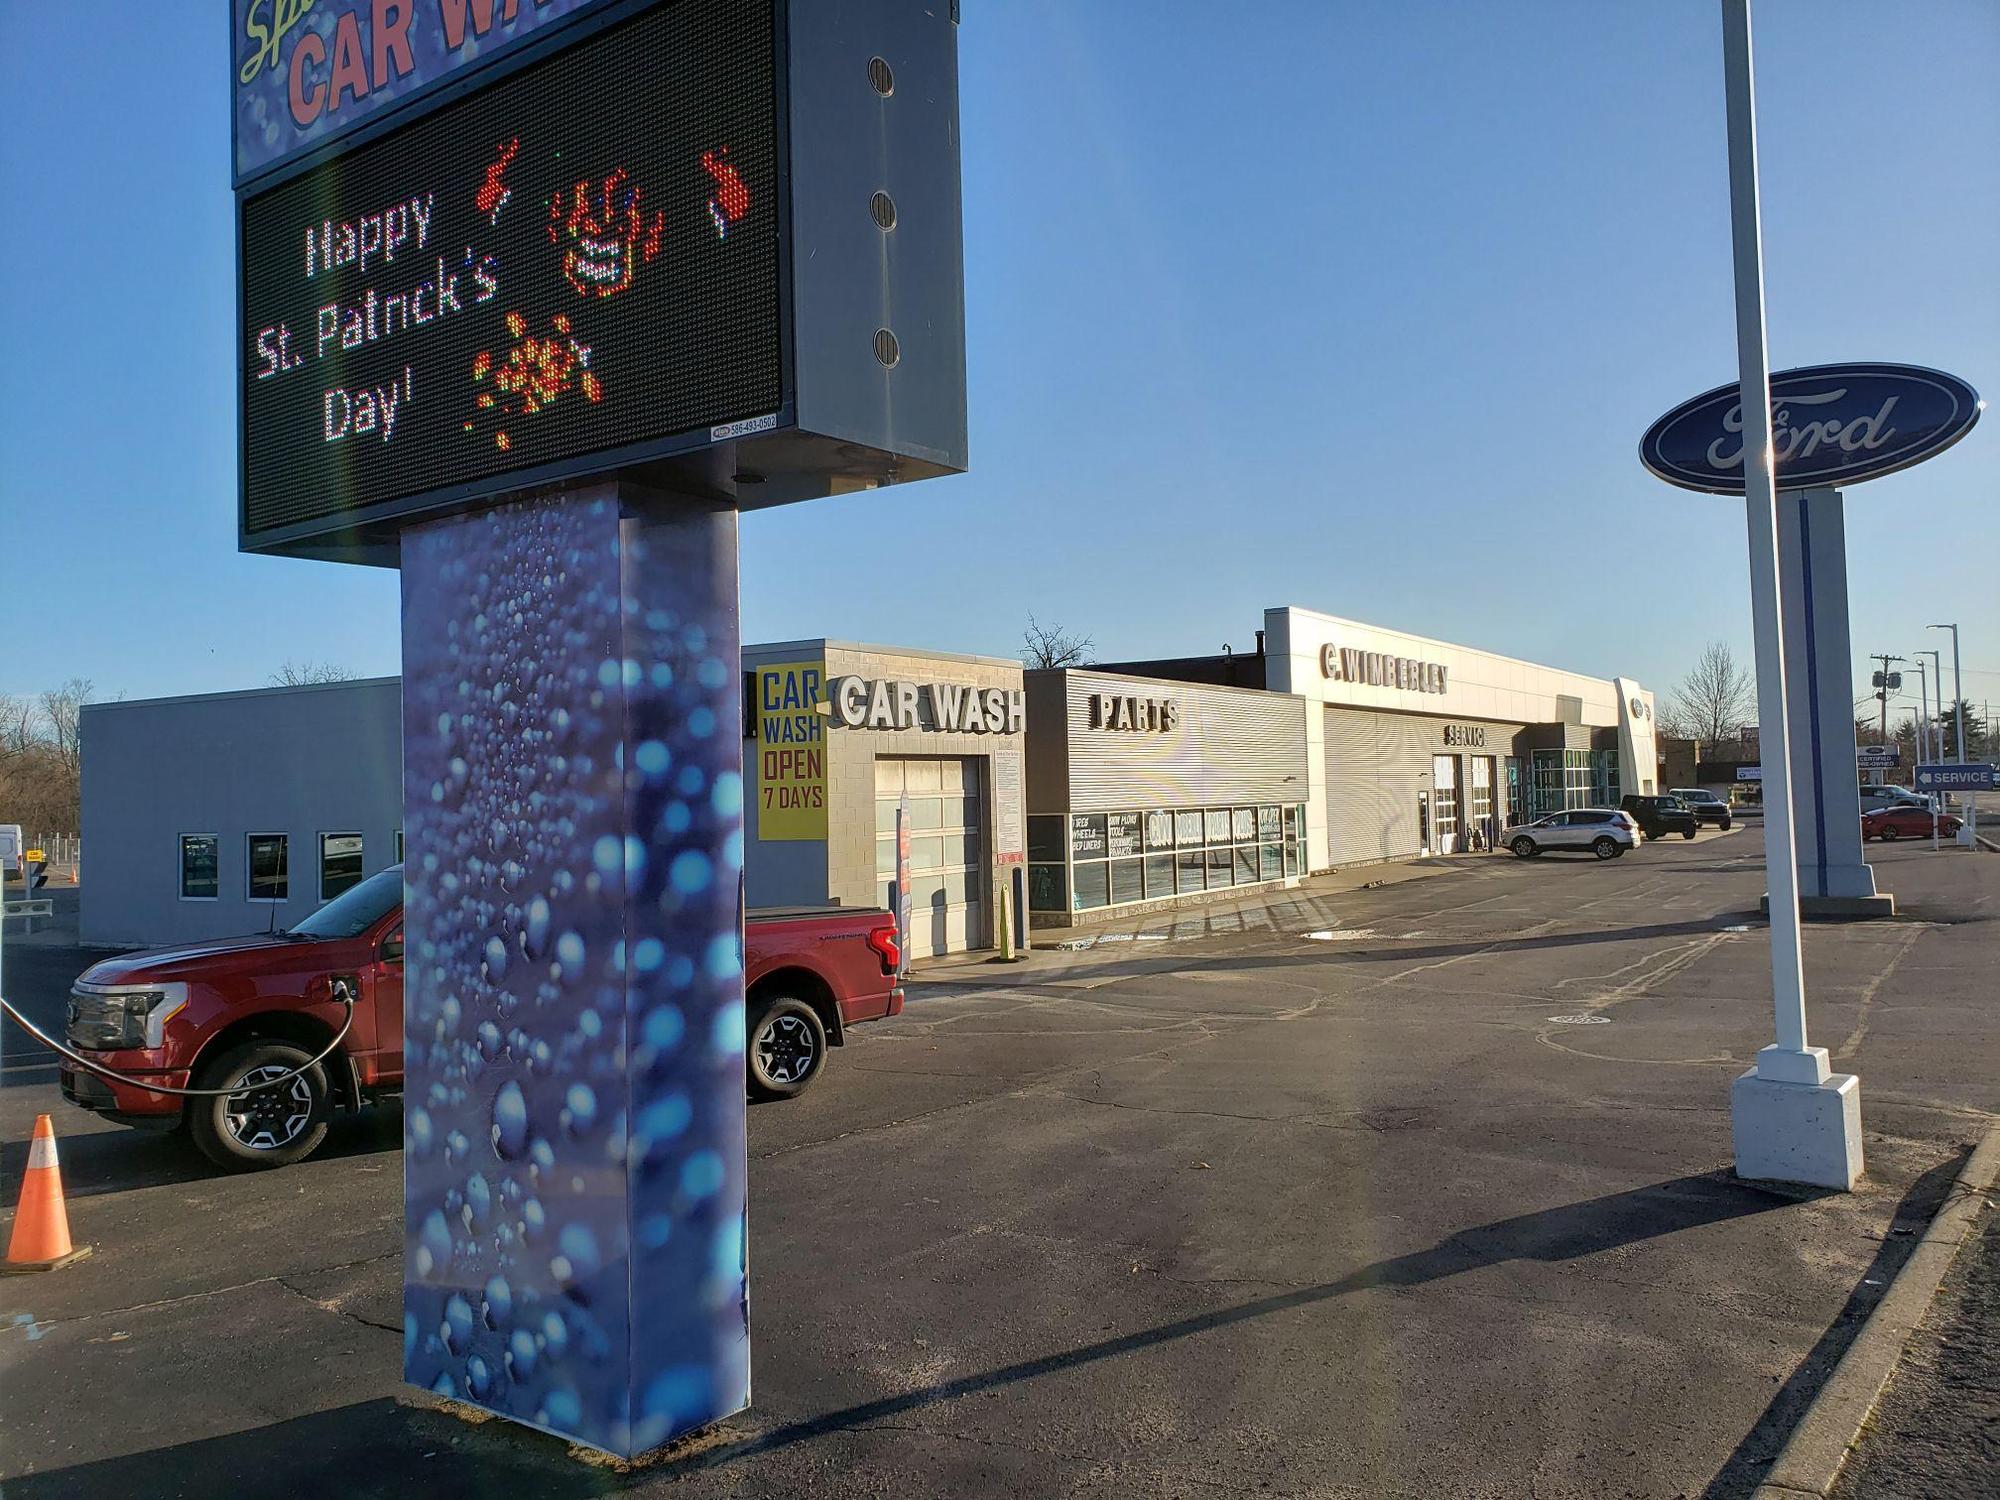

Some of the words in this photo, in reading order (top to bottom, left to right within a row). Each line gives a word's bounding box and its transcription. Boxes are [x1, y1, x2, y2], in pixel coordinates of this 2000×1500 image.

[288, 0, 415, 126] CAR
[305, 192, 435, 278] Happy
[256, 323, 303, 380] St.
[731, 416, 776, 436] 586-493-0502
[1706, 388, 1901, 470] Ford
[763, 669, 819, 711] CAR
[836, 673, 921, 727] CAR
[929, 683, 1026, 732] WASH
[763, 714, 821, 744] WASH
[1095, 693, 1180, 731] PARTS
[763, 748, 822, 780] OPEN
[1934, 771, 1989, 783] SERVICE
[763, 787, 774, 809] 7
[779, 785, 823, 809] DAYS
